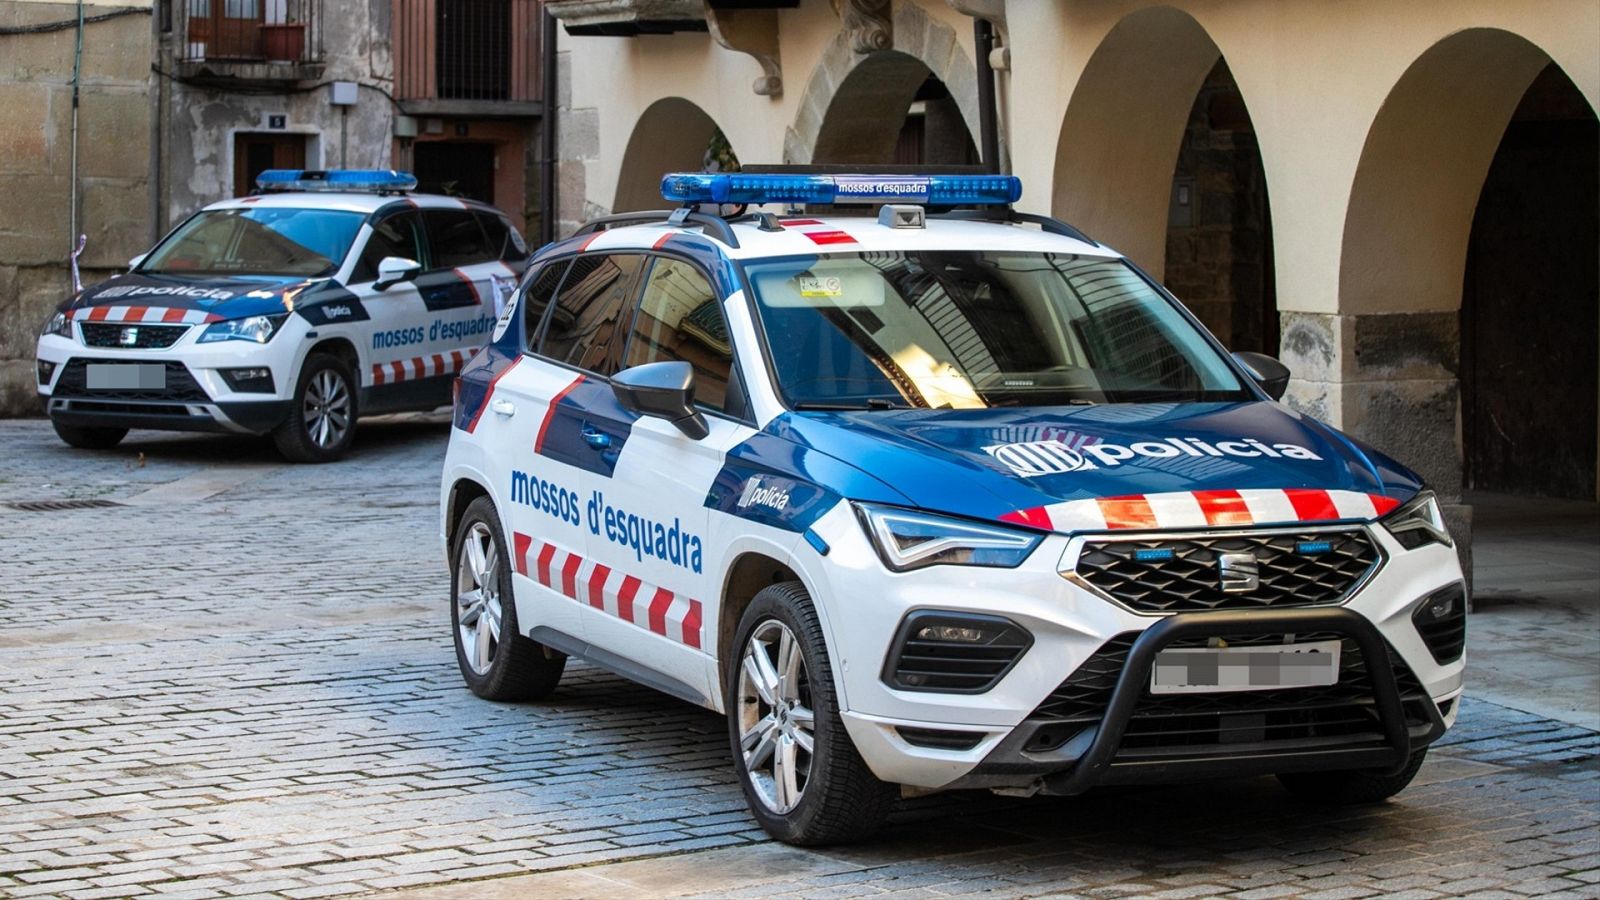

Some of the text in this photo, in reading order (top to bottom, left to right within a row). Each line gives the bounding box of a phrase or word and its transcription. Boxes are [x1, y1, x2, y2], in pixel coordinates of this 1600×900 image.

[838, 182, 927, 195] mossos d'esquadra
[128, 286, 234, 300] policia
[372, 327, 424, 350] mossos
[1095, 438, 1322, 466] policia
[748, 486, 790, 510] policia
[511, 470, 703, 574] mossos d'esquadra
